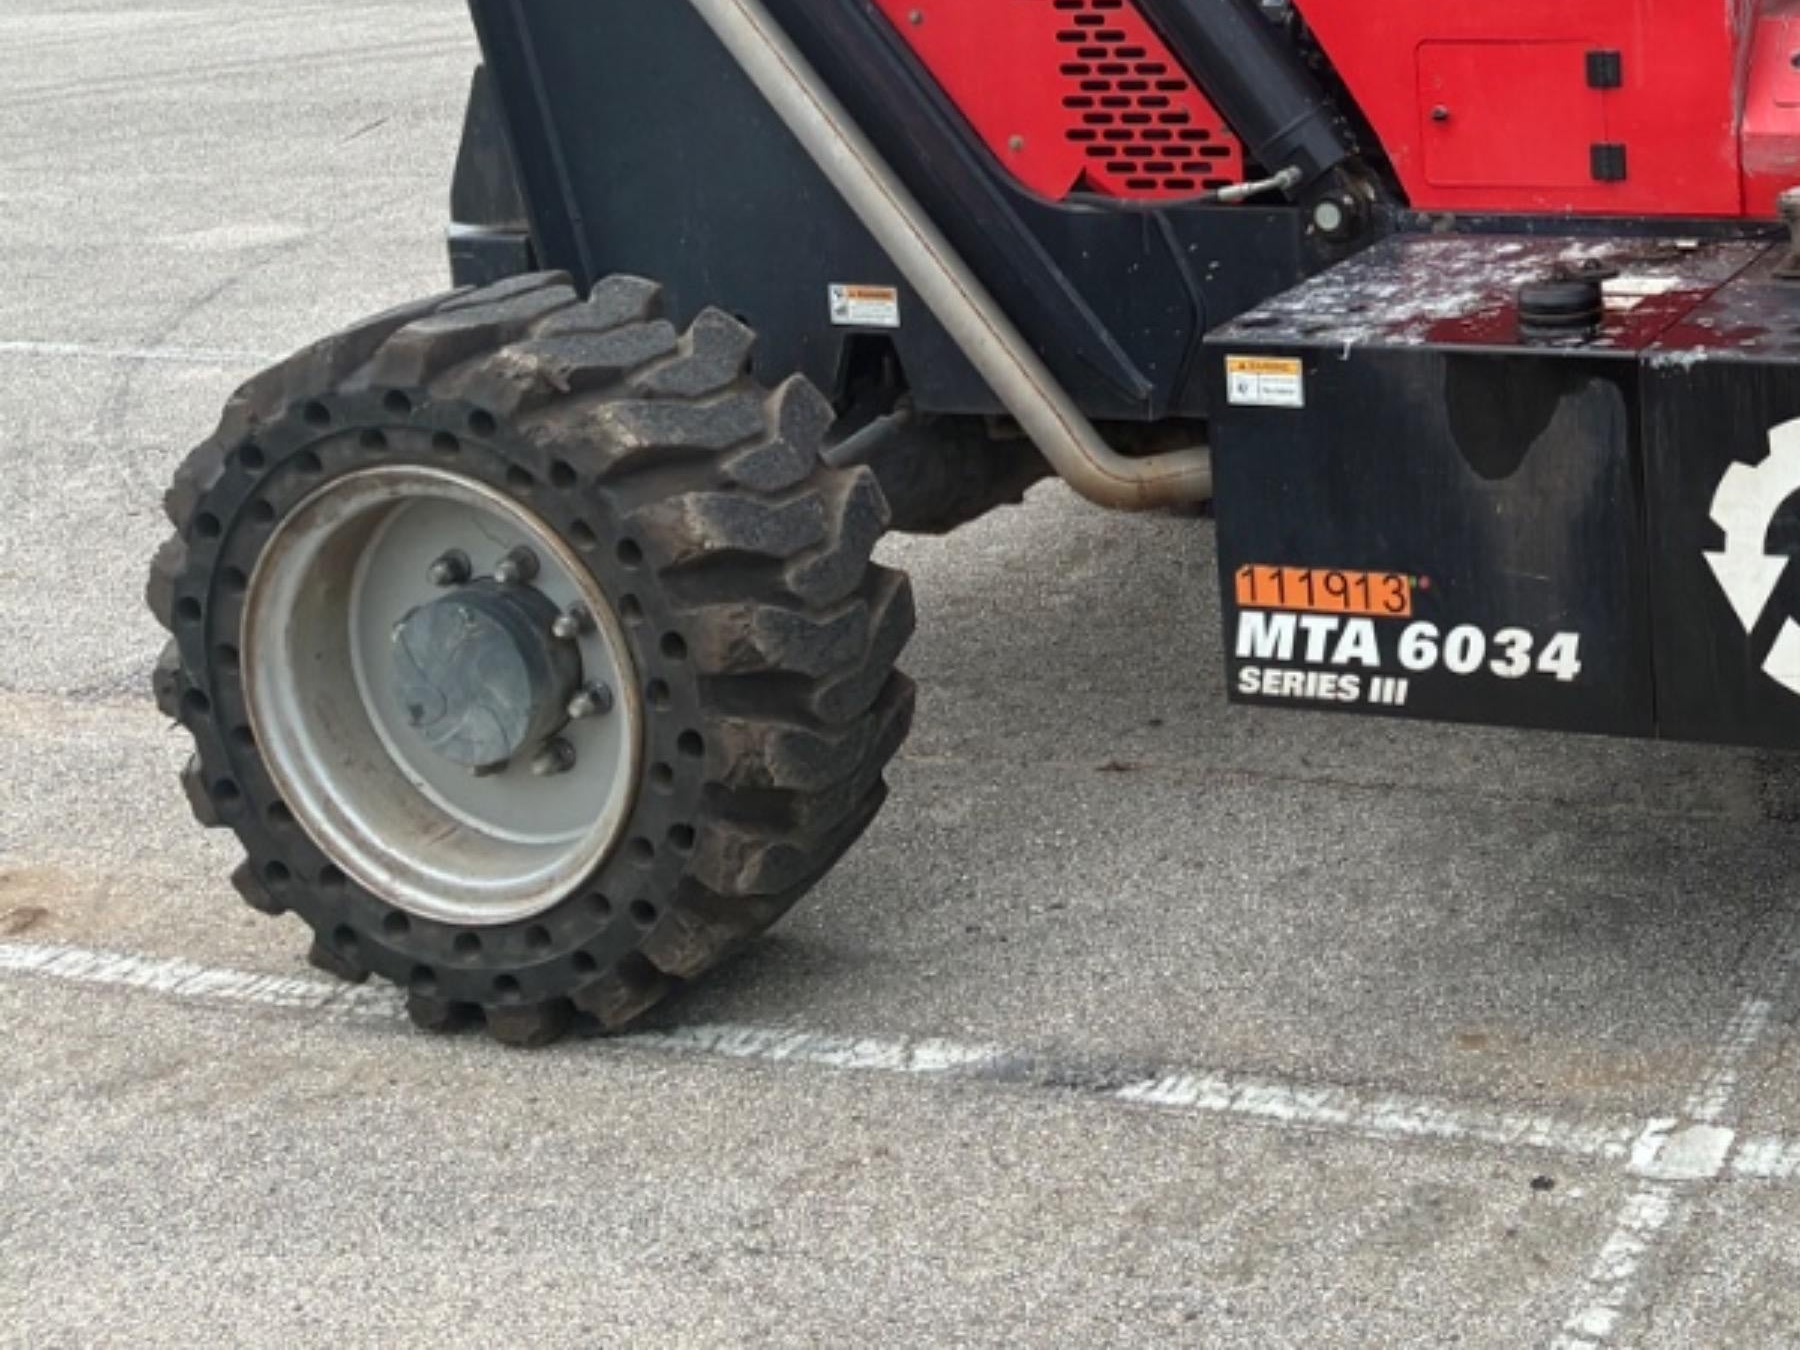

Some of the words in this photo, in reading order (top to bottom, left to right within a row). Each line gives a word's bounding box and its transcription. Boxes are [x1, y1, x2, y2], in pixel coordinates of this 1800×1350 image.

[1240, 567, 1408, 613] 111913
[1236, 610, 1382, 668] MTA
[1397, 621, 1584, 682] 6034
[1238, 665, 1361, 702] SERIES
[1367, 677, 1409, 706] III
